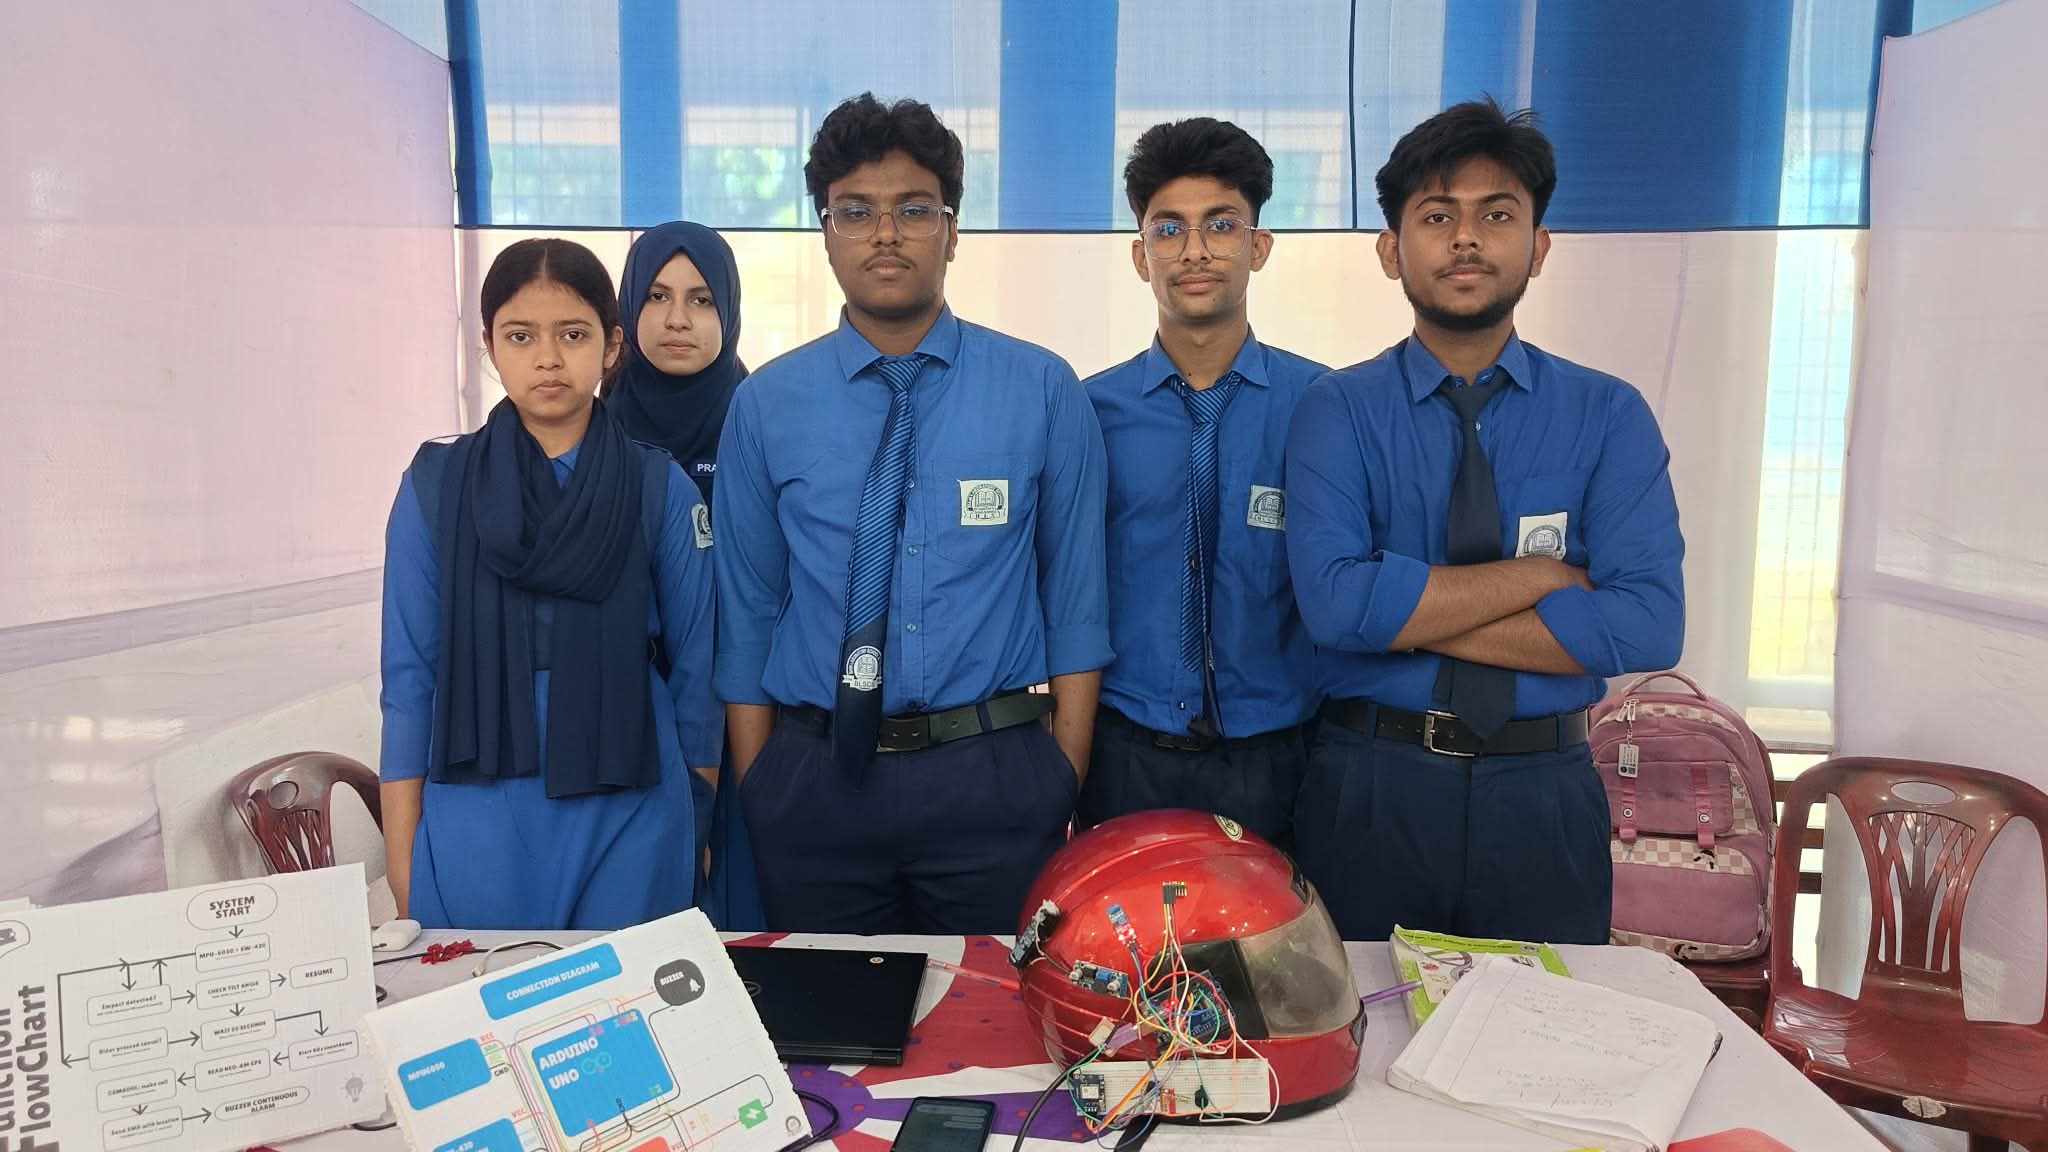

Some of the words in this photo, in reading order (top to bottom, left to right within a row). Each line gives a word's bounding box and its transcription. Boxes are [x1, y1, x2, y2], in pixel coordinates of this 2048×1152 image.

[209, 896, 255, 911] SYSTEM
[216, 905, 251, 919] START
[305, 968, 334, 978] RESUME
[660, 971, 685, 986] BUZZER
[506, 974, 561, 1001] CONNECTION
[561, 961, 600, 982] DIAGRAM
[539, 1037, 599, 1071] ARDUINO
[549, 1068, 580, 1090] UNO
[225, 1102, 251, 1113] BUZZER
[251, 1103, 276, 1113] ALARM
